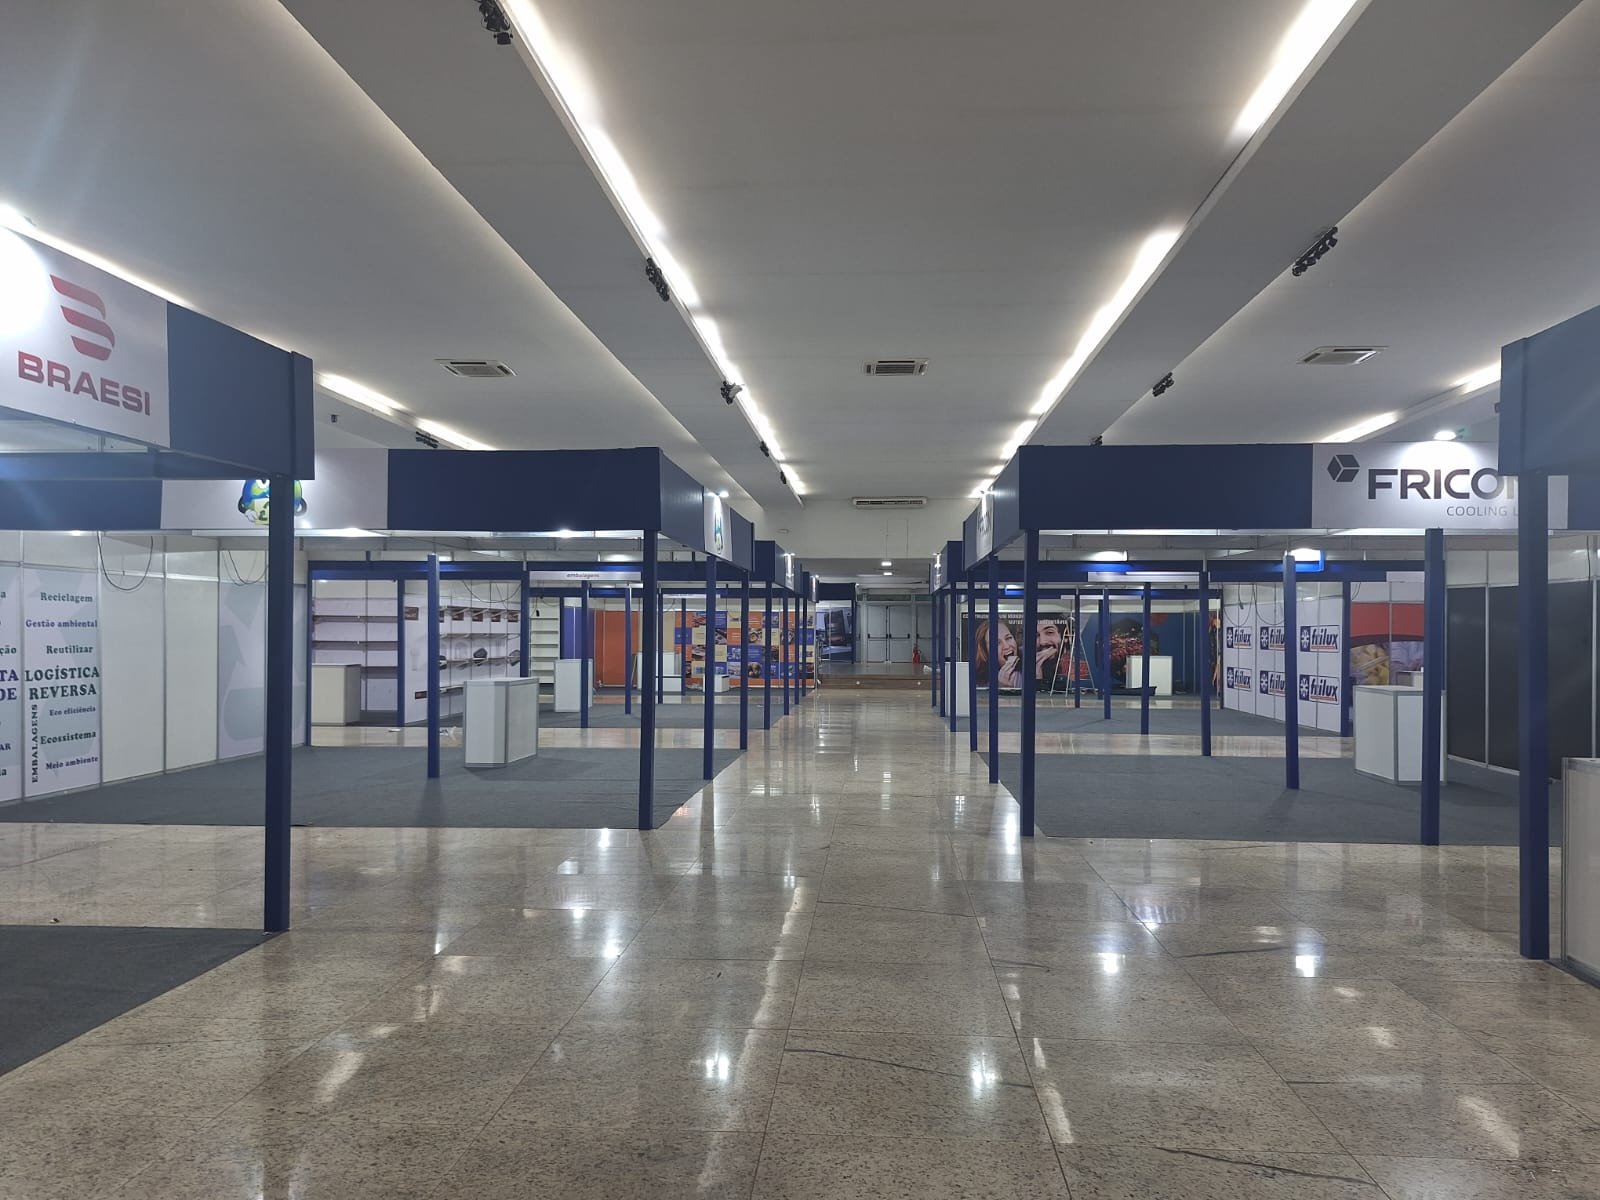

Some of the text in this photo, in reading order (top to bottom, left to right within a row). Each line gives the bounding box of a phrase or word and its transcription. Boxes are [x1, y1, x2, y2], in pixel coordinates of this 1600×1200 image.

[18, 351, 150, 416] BRAESI
[1446, 506, 1507, 517] COOLING
[40, 592, 93, 603] Reciclagem
[25, 619, 98, 628] Gestão ambiental
[1270, 628, 1285, 644] frilu
[1312, 628, 1338, 650] frilux
[46, 645, 94, 654] Reutilizar
[25, 665, 100, 682] LOGÍSTICA
[1269, 673, 1285, 690] frilu
[29, 684, 97, 700] REVERSA
[1311, 679, 1338, 702] frilux
[64, 705, 96, 715] eficiência
[40, 731, 96, 745] Ecossistema
[46, 756, 98, 770] Meio ambiente
